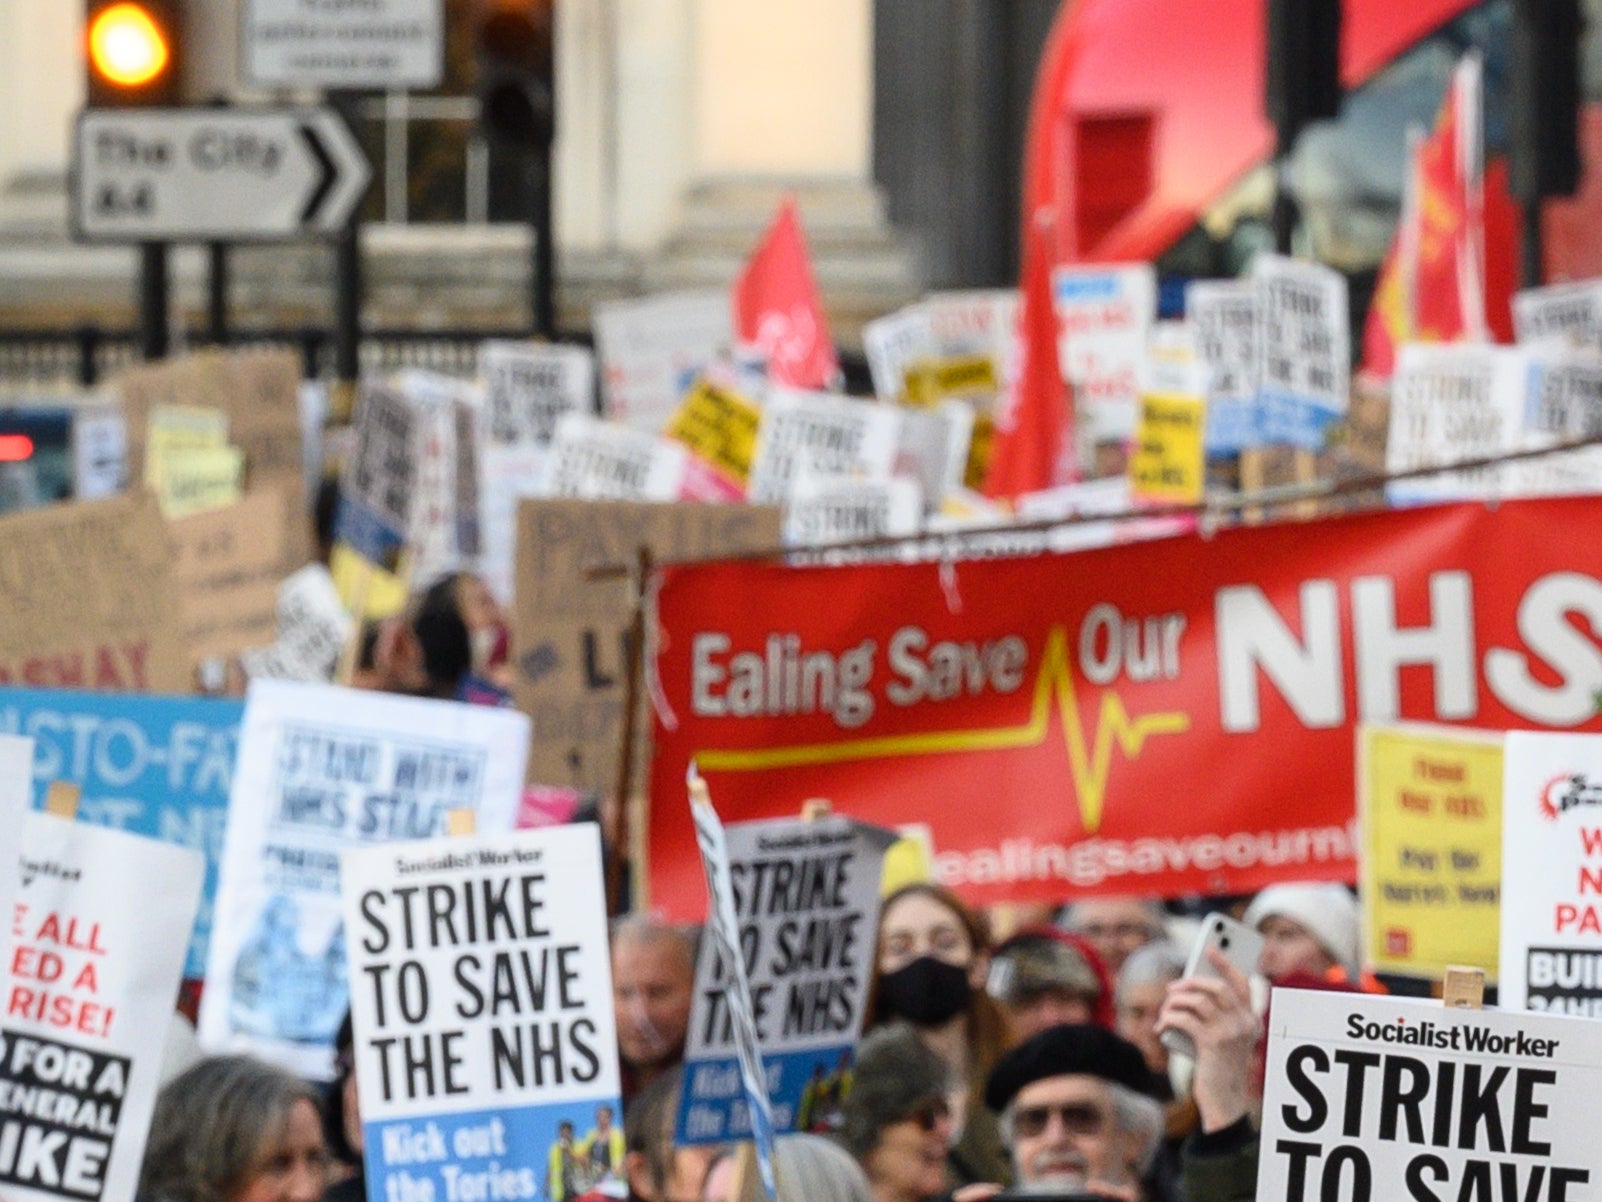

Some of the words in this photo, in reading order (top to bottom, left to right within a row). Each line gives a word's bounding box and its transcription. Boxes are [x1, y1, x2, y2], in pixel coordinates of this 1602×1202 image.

[691, 632, 876, 727] Ealing
[887, 625, 1027, 706] Save
[1079, 602, 1188, 686] Our
[36, 909, 108, 956] ALL
[360, 874, 552, 955] STRIKE
[771, 913, 864, 977] SAVE
[72, 960, 100, 995] A
[363, 959, 430, 1028] TO
[453, 945, 586, 1020] SAVE
[781, 975, 857, 1038] NHS
[6, 985, 117, 1040] RISE!
[9, 1039, 95, 1092] FOR
[94, 1058, 125, 1100] A
[370, 1030, 470, 1102] THE
[490, 1018, 601, 1091] NHS
[1281, 1043, 1557, 1158] STRIKE
[380, 1121, 448, 1166] Kick
[453, 1118, 507, 1159] out
